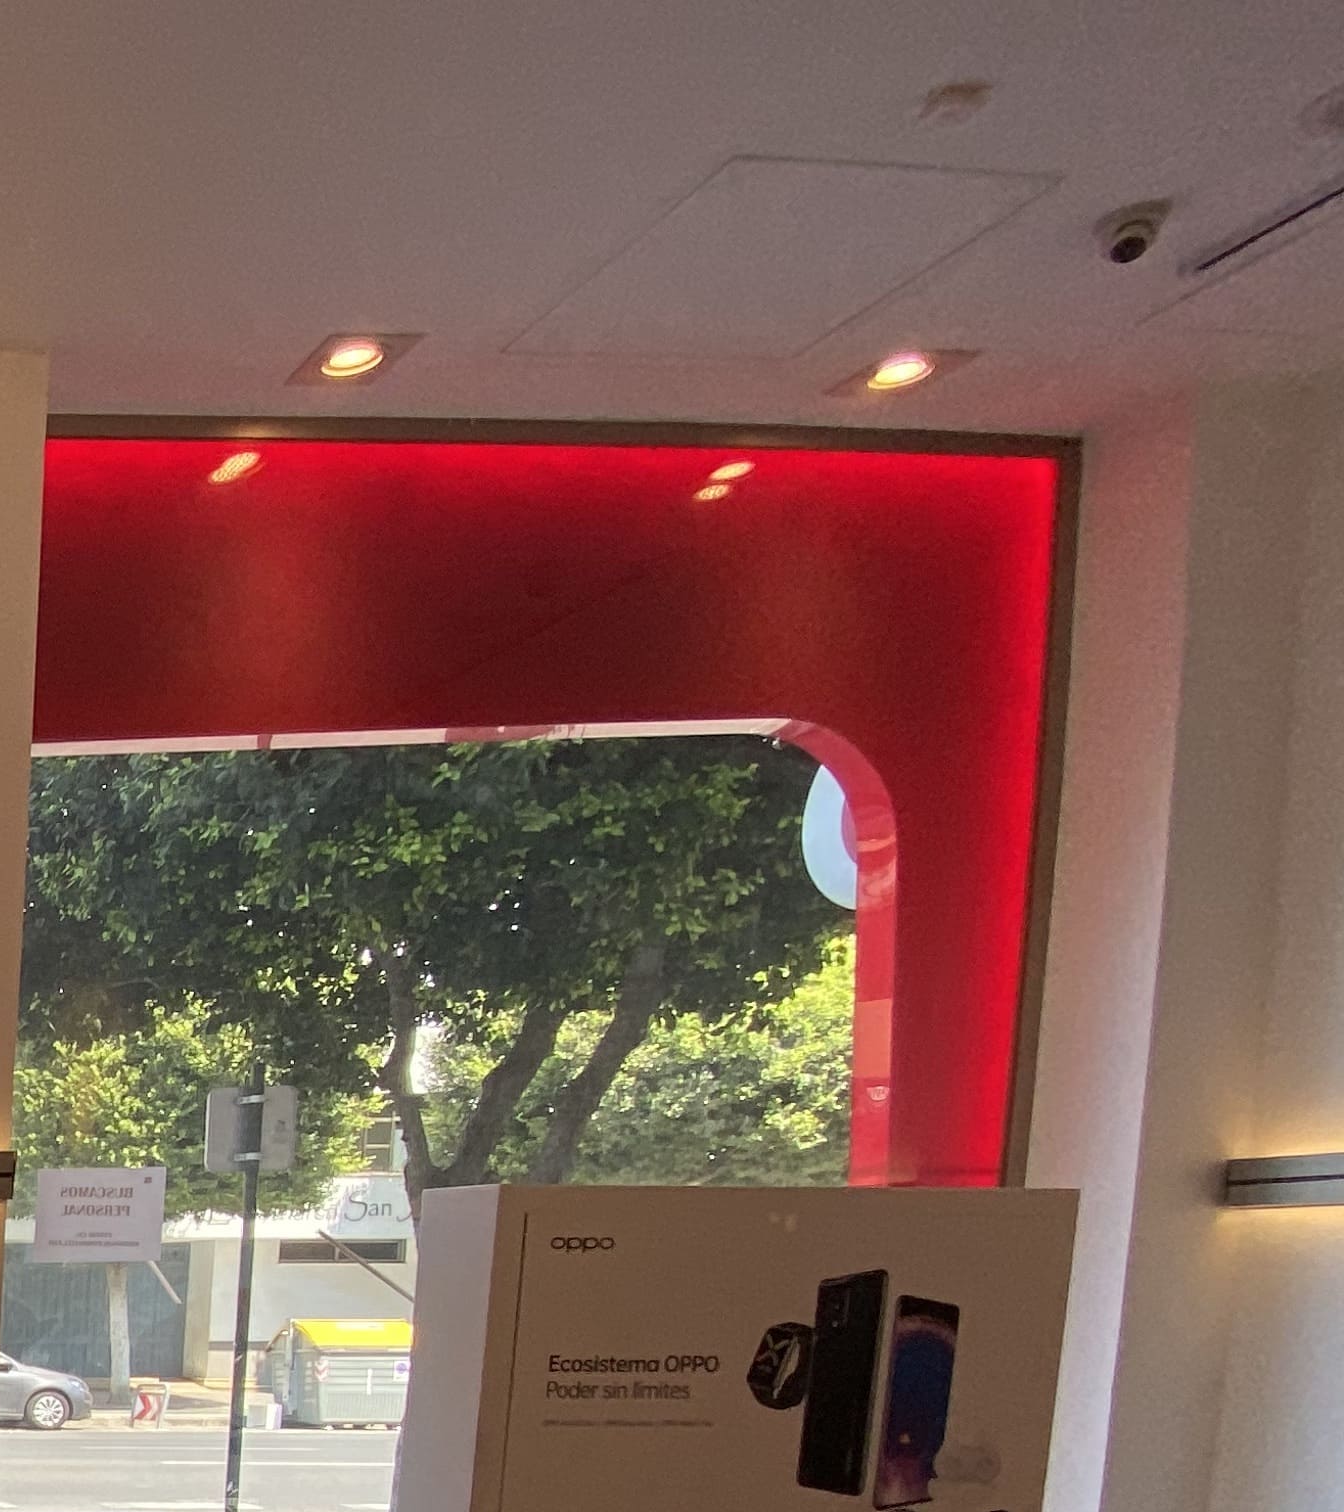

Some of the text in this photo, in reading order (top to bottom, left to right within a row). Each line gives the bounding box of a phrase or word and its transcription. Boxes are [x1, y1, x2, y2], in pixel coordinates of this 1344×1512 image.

[344, 1192, 392, 1222] San
[551, 1236, 615, 1254] oppo
[549, 1355, 720, 1373] Ecosistema OPPO
[546, 1381, 690, 1400] Poder sin límites
